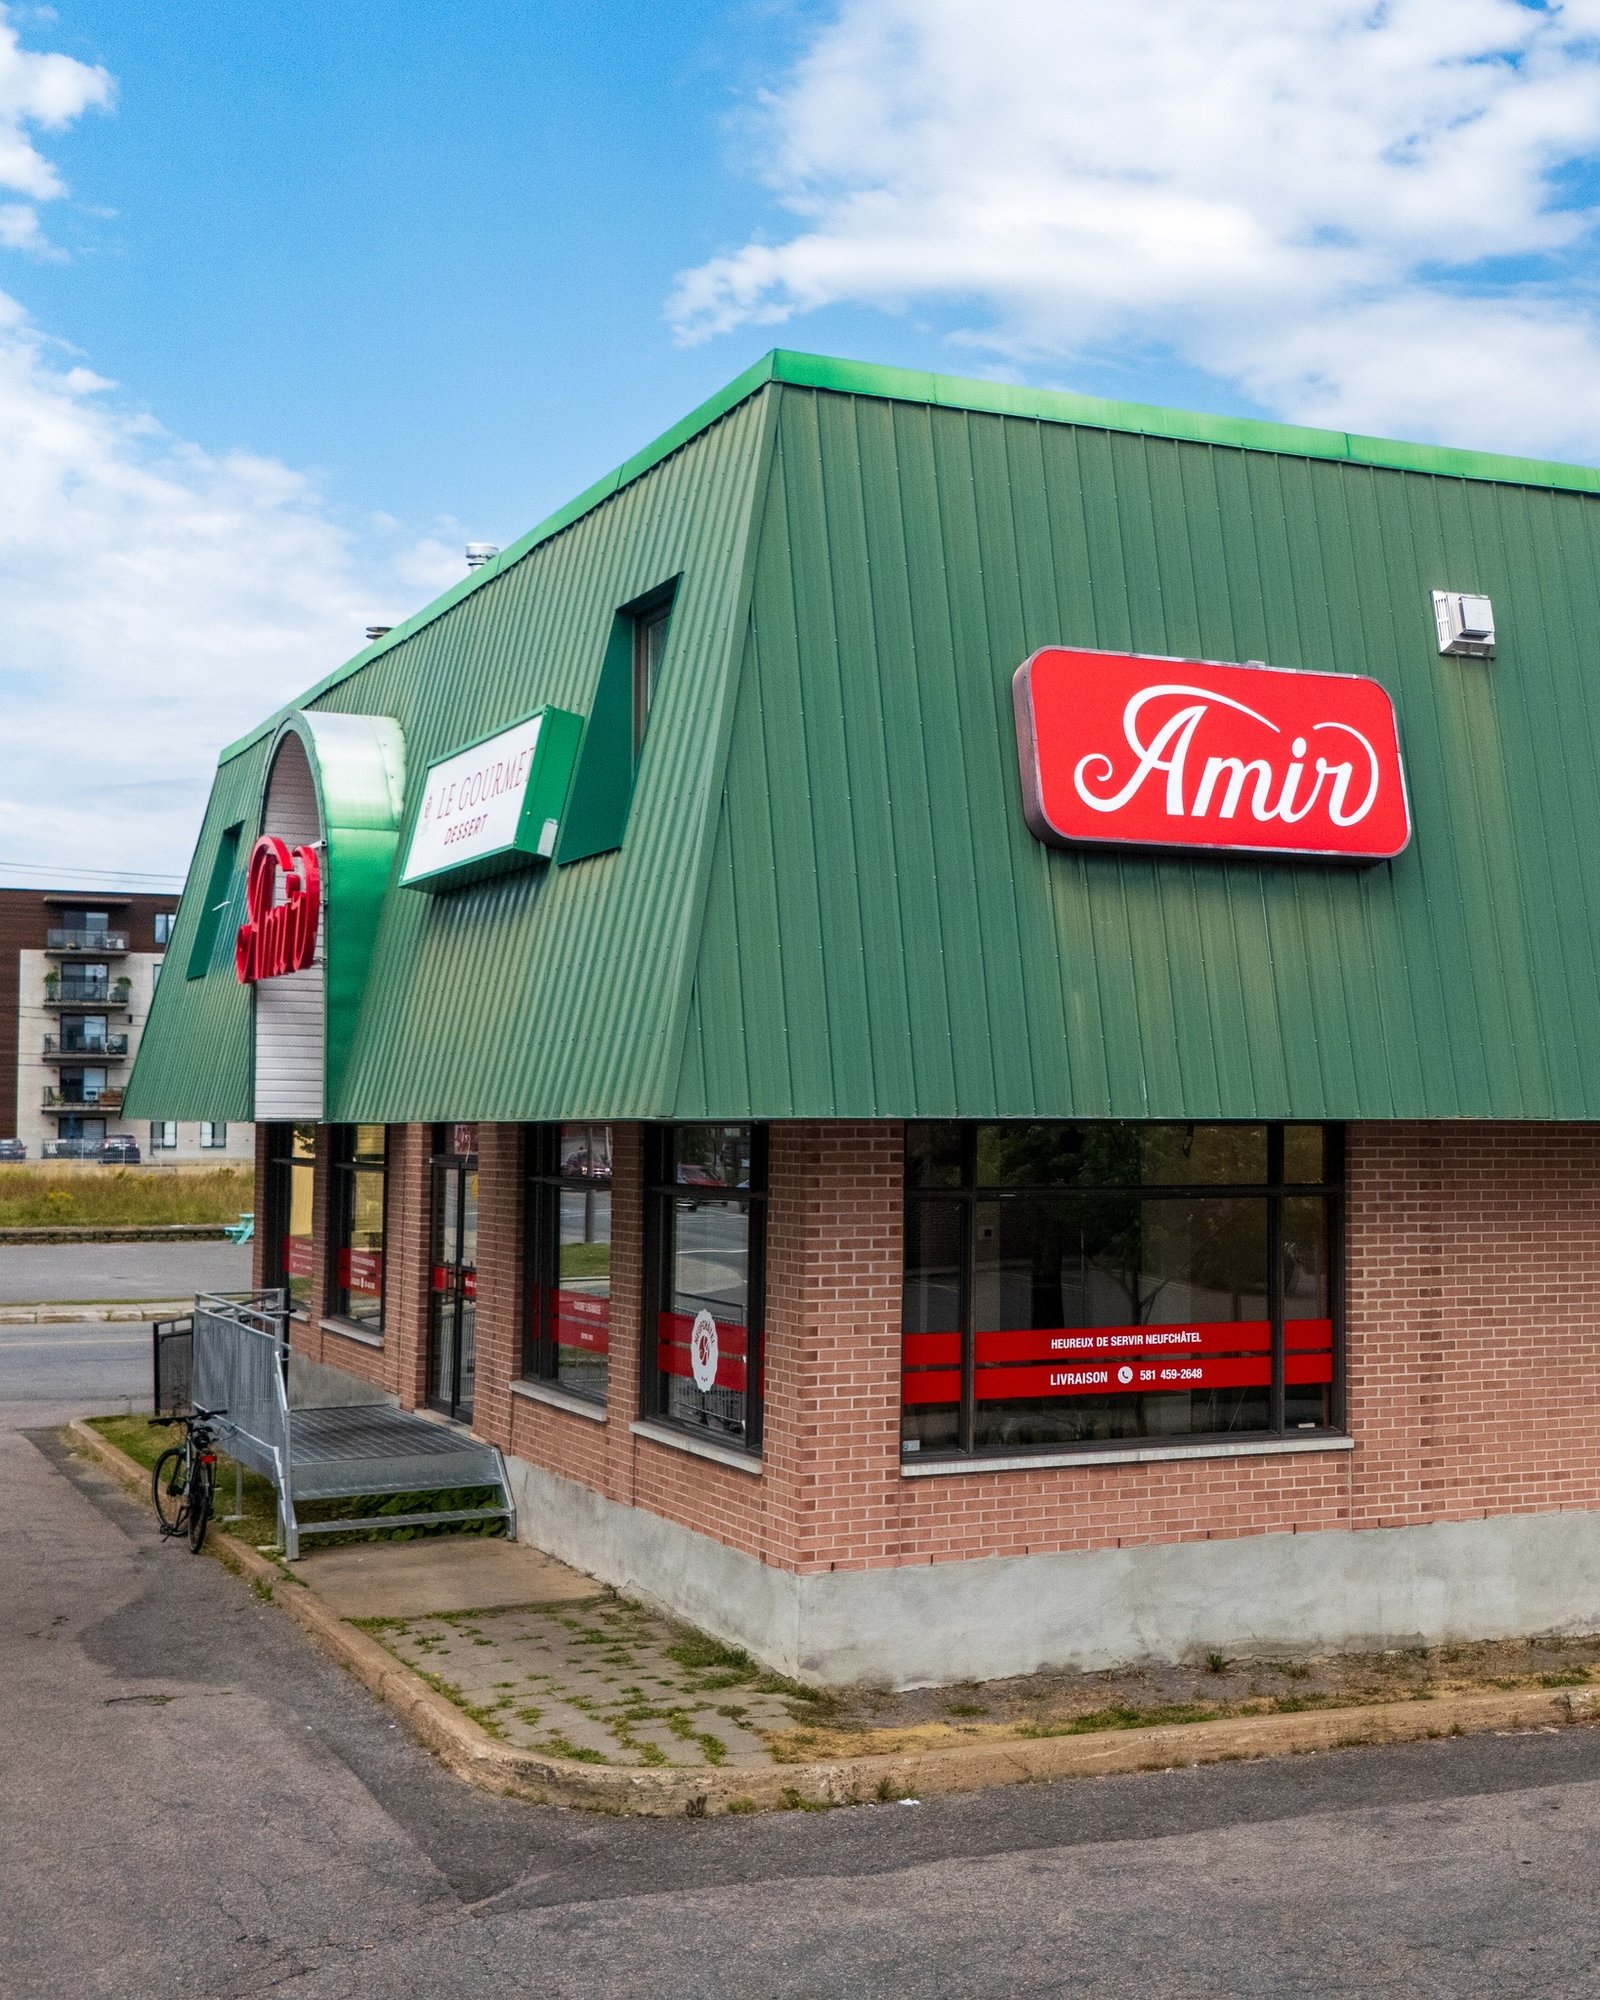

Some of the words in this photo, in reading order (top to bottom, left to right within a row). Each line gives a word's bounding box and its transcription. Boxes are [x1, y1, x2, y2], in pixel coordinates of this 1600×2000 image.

[1073, 684, 1379, 827] Amir
[436, 784, 457, 820] LE
[458, 747, 535, 811] GOURMET
[444, 813, 488, 845] DESSERT
[1051, 1337, 1094, 1349] HEUREUX
[1096, 1336, 1109, 1347] DE
[1110, 1335, 1144, 1346] SERVIR
[1145, 1331, 1202, 1345] NEUFCHÂTEL
[1050, 1371, 1108, 1386] LIVRAISON
[1139, 1369, 1156, 1380] 581
[1160, 1368, 1203, 1380] 459-2648
